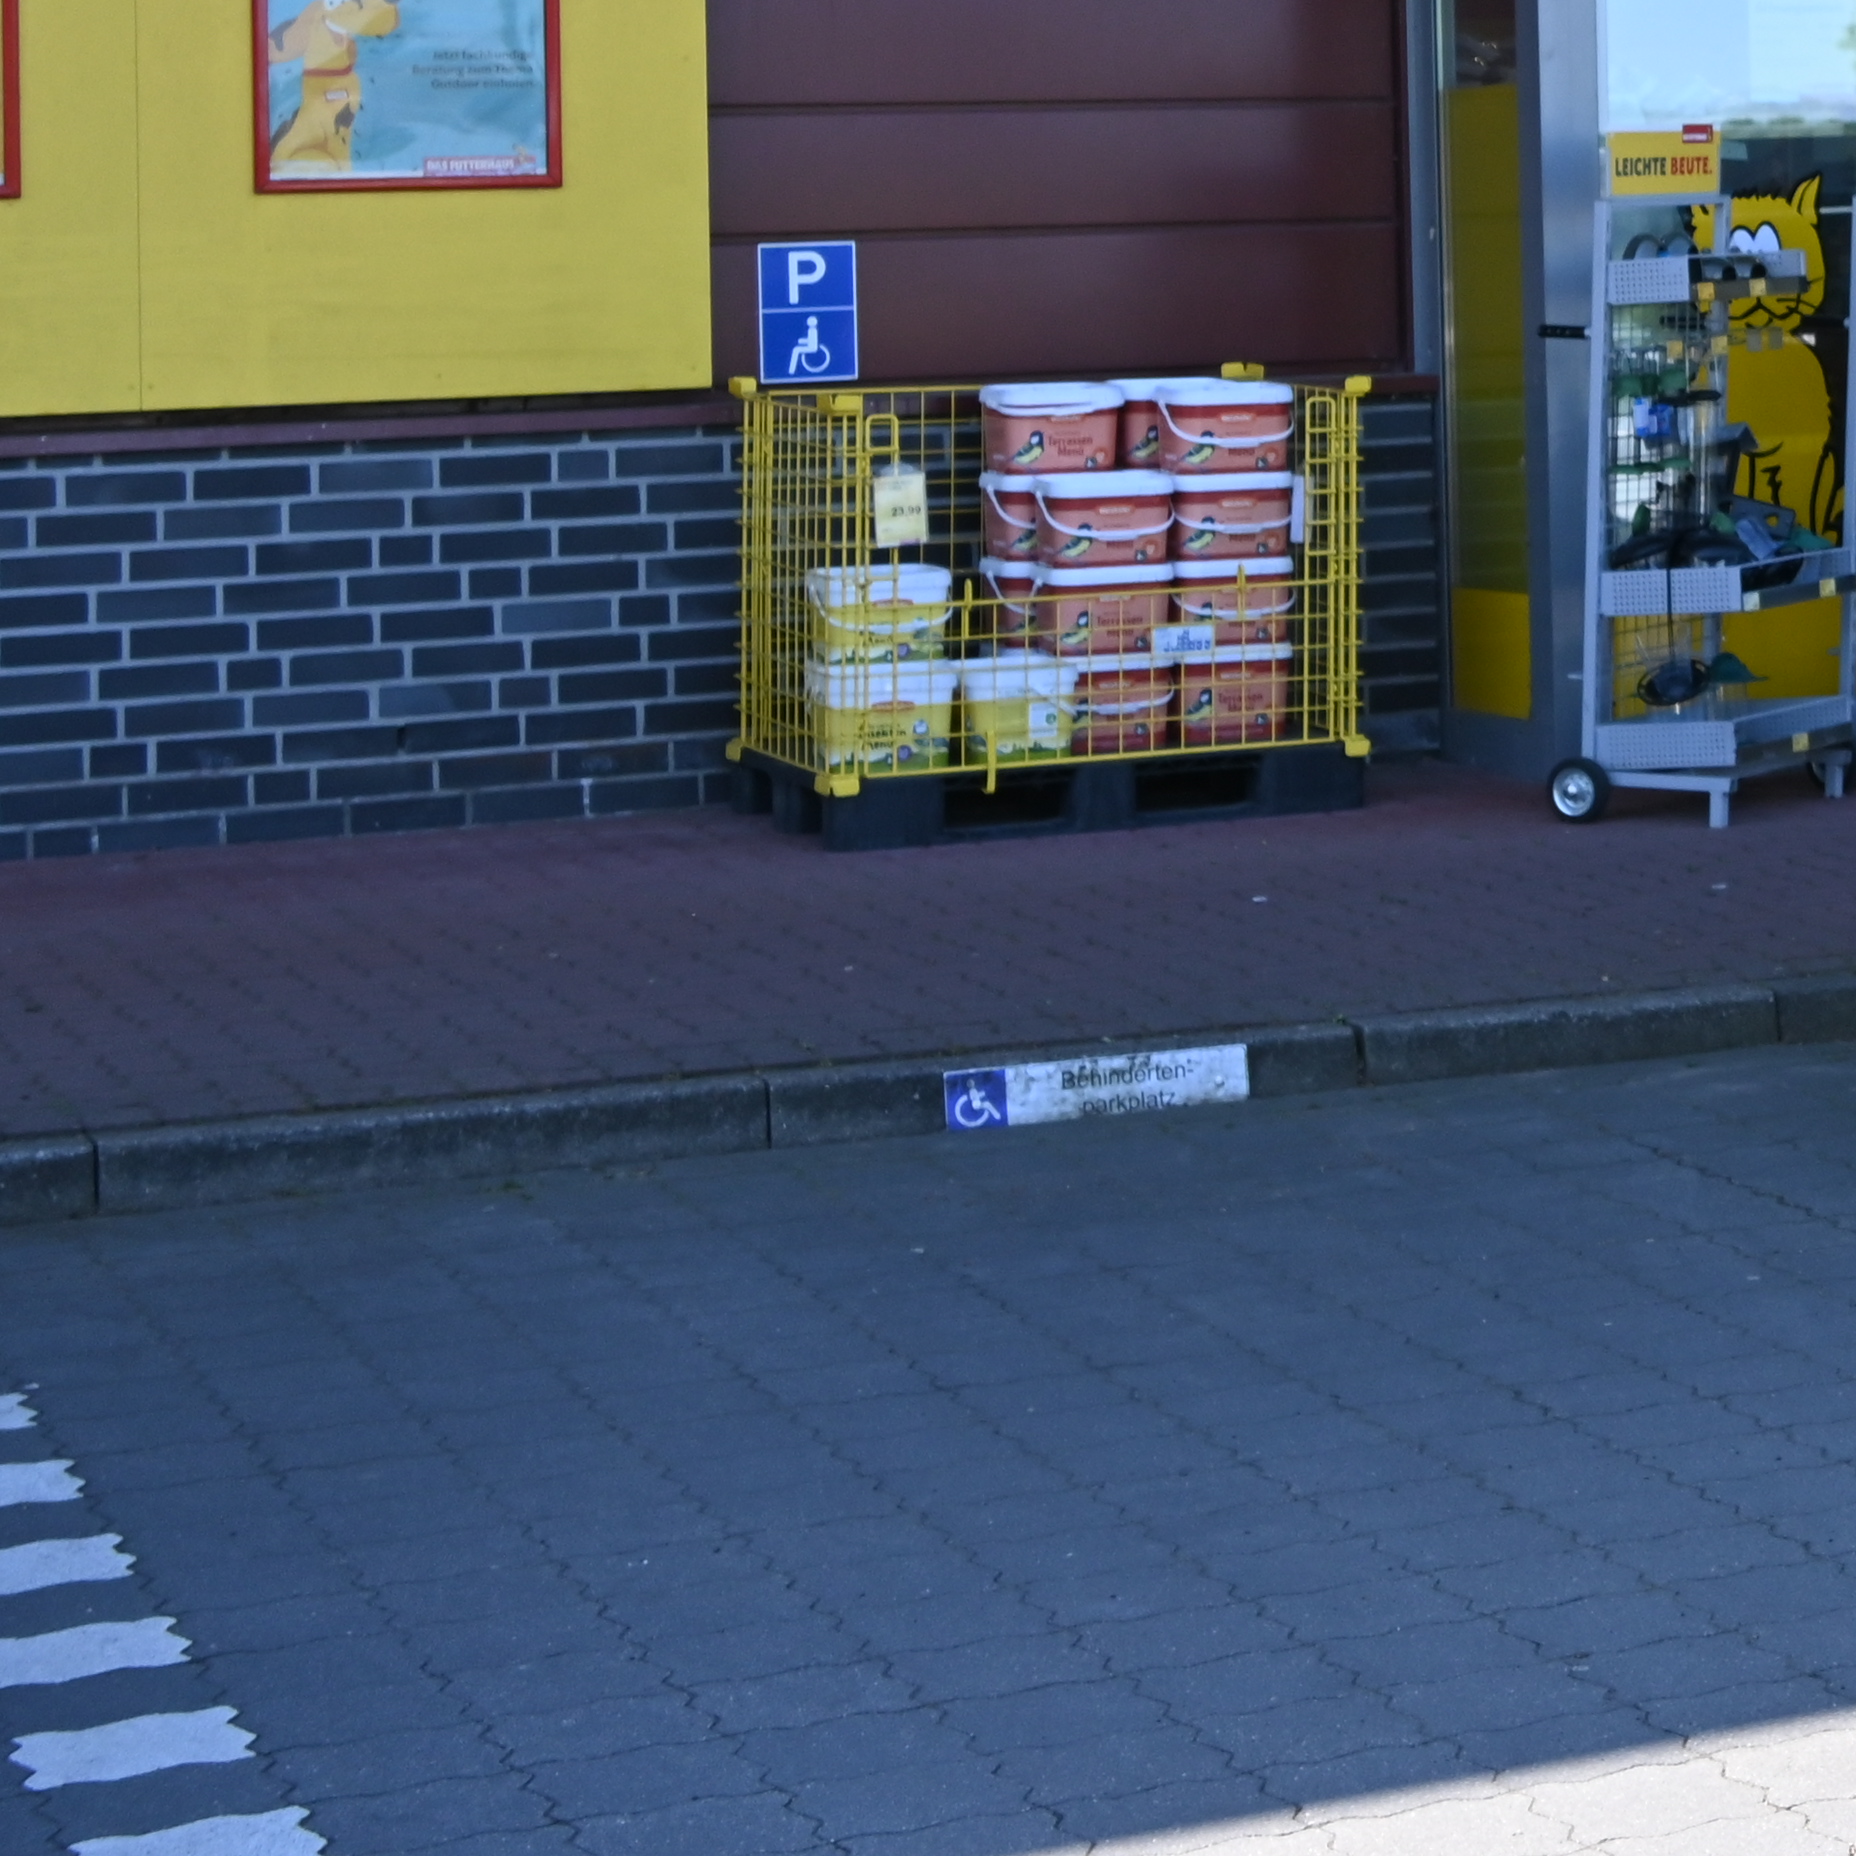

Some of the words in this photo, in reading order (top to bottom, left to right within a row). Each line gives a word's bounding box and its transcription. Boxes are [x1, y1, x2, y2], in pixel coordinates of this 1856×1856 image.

[1615, 157, 1666, 177] LEICHTE
[1671, 156, 1713, 176] BEUTE.
[788, 251, 826, 304] P
[1061, 1062, 1195, 1090] Behinderten-
[1081, 1090, 1176, 1114] parkplatz
